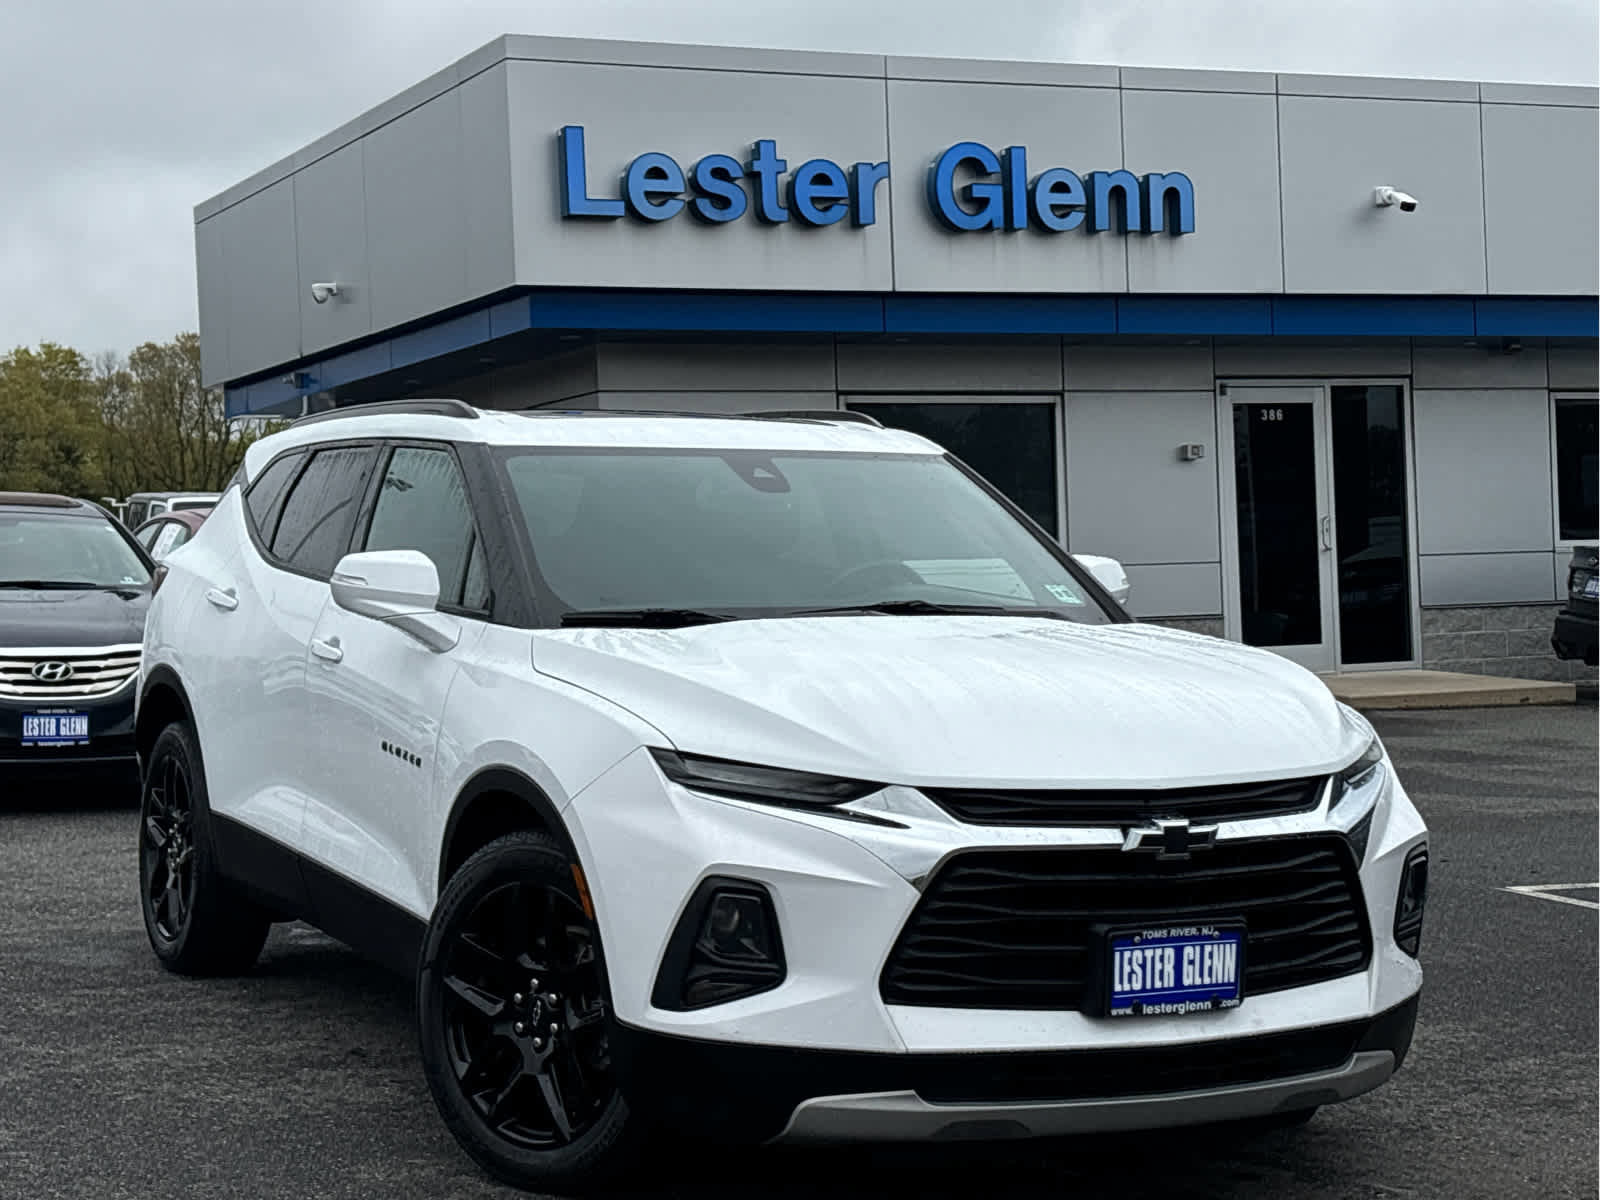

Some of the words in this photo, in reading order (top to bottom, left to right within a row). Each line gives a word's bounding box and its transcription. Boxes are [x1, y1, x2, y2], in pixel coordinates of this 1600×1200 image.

[559, 126, 889, 226] Lester
[928, 142, 1195, 234] Glenn
[1261, 409, 1283, 421] 386
[23, 717, 56, 736] LESTER
[60, 716, 88, 736] GLENN
[1142, 929, 1168, 939] TOMS
[1114, 947, 1175, 992] LESTER
[1182, 943, 1237, 986] GLENN
[1143, 1001, 1212, 1015] lesterglenn
